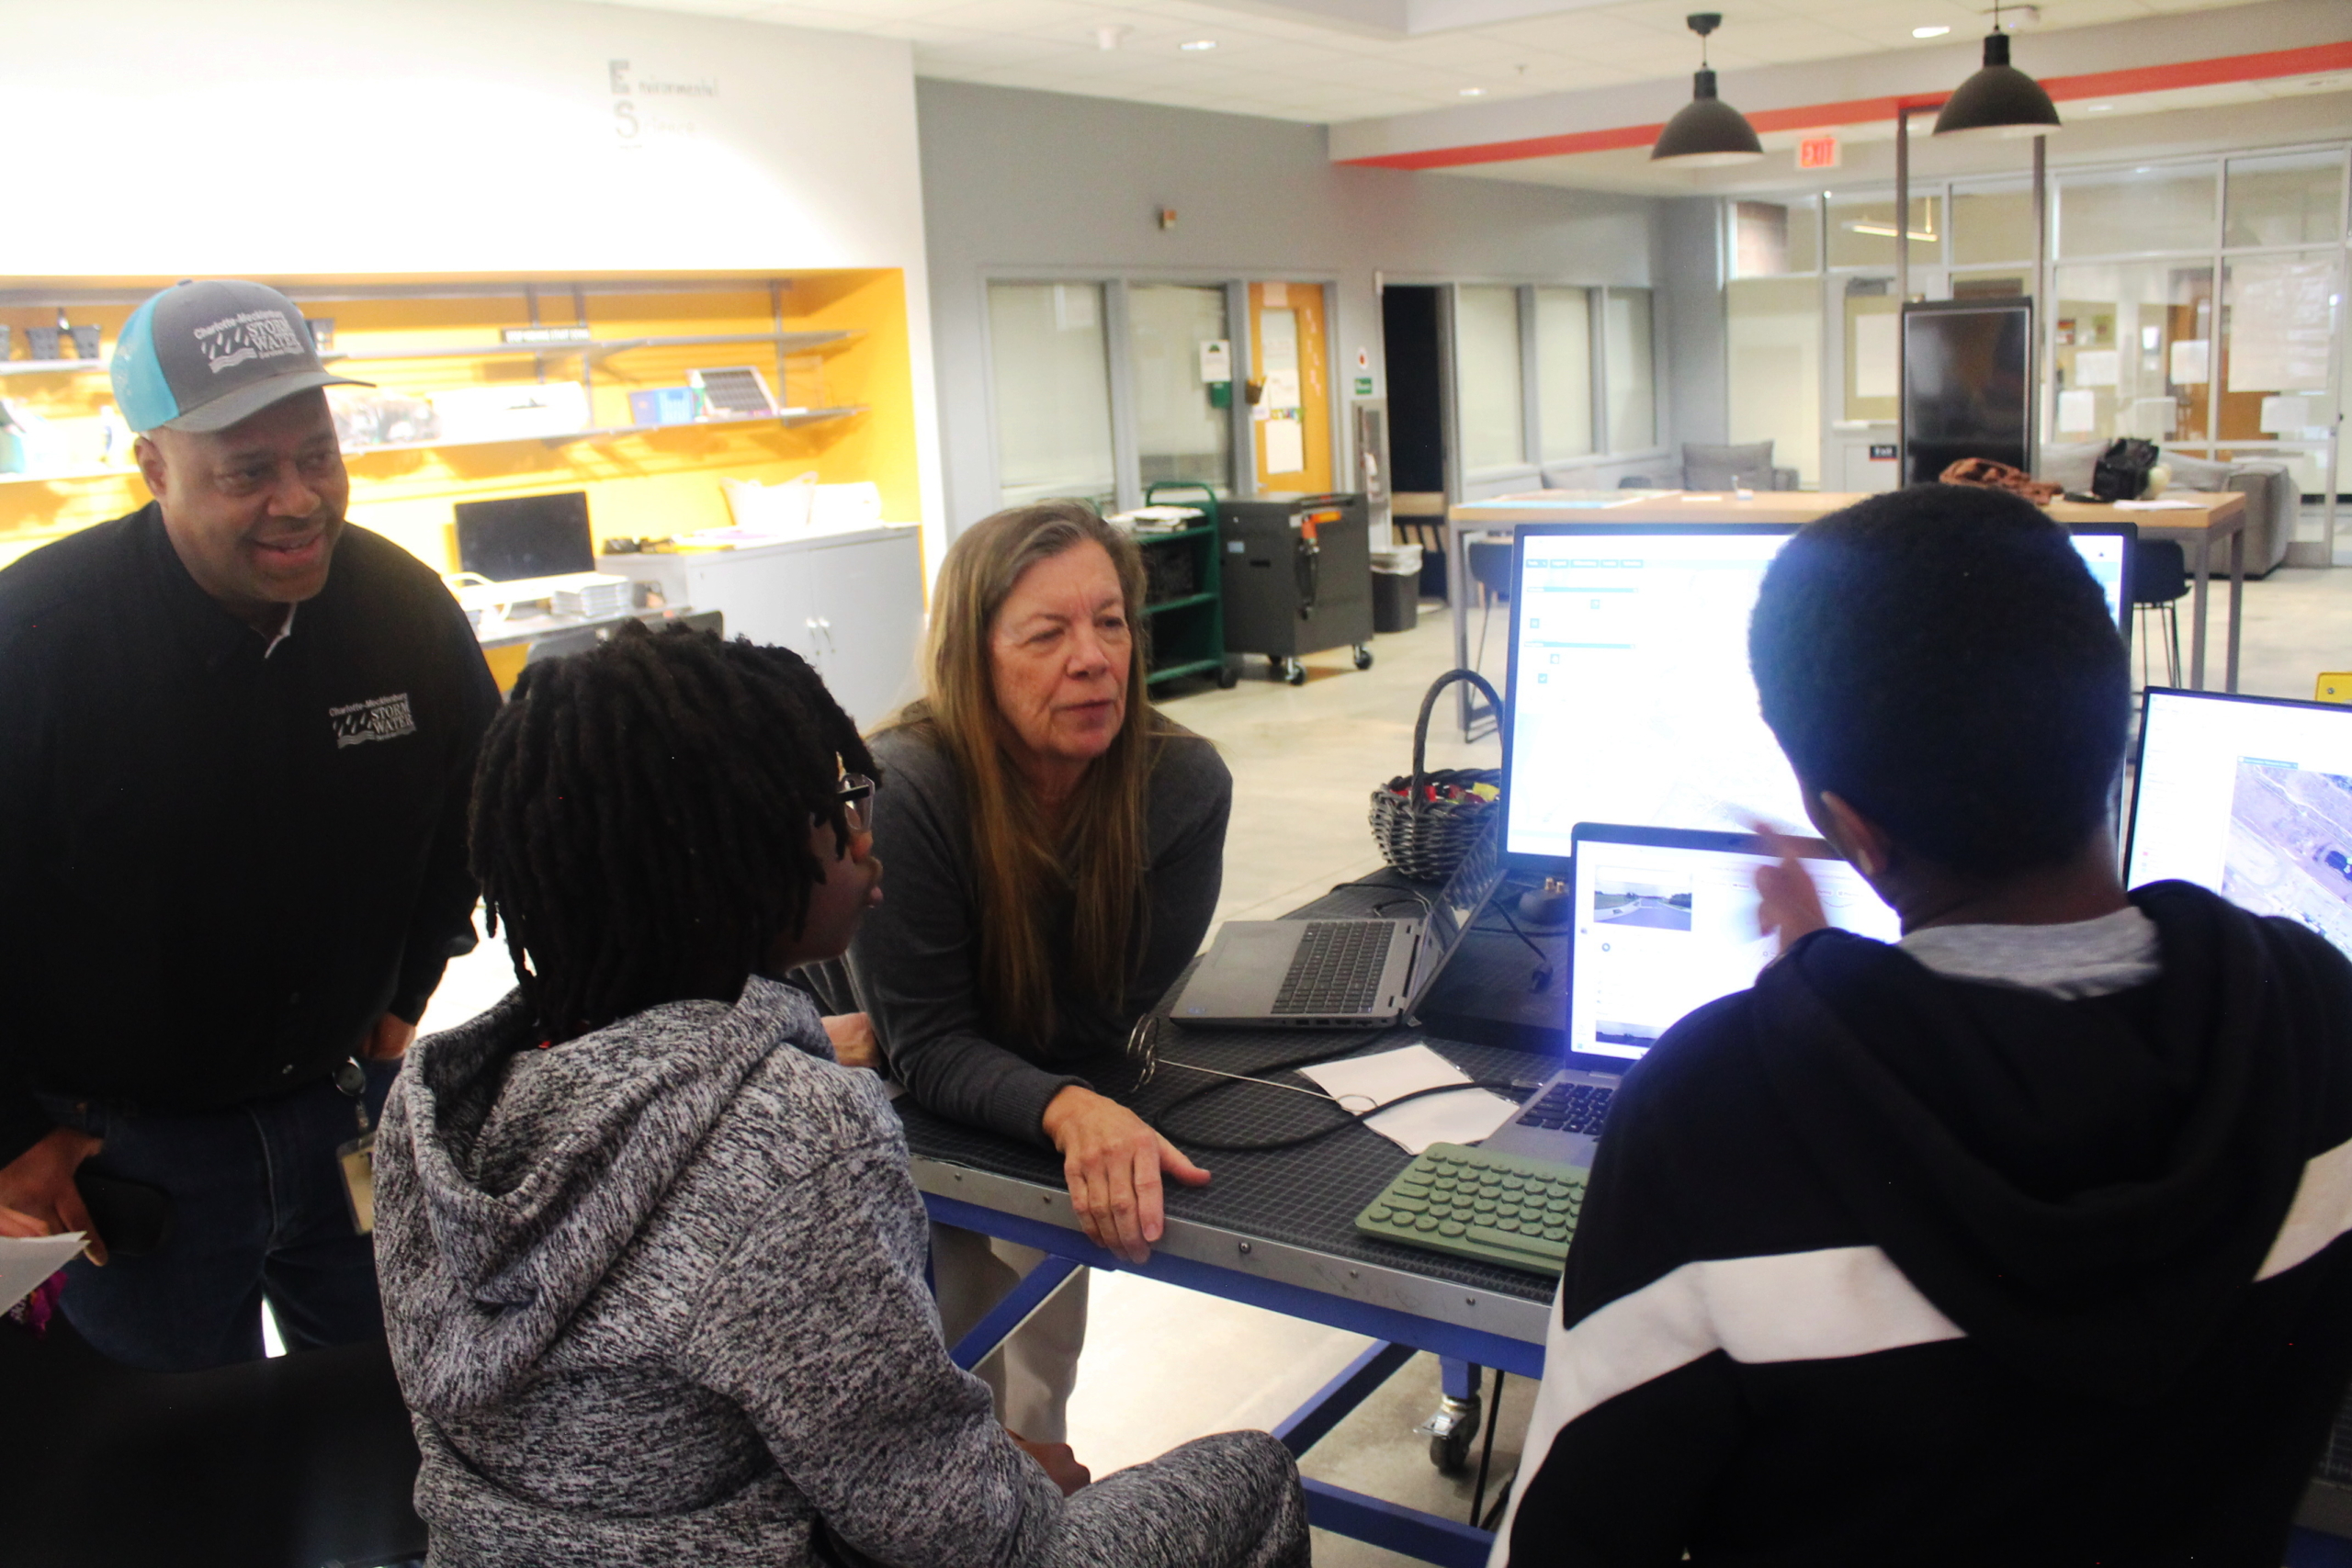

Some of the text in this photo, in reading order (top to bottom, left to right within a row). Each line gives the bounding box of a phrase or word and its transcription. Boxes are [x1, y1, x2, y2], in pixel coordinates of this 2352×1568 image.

[1802, 139, 1836, 167] EXIT
[245, 319, 294, 338] STORM
[250, 333, 300, 352] WATER
[370, 702, 411, 720] STORM
[372, 714, 413, 735] WATER
